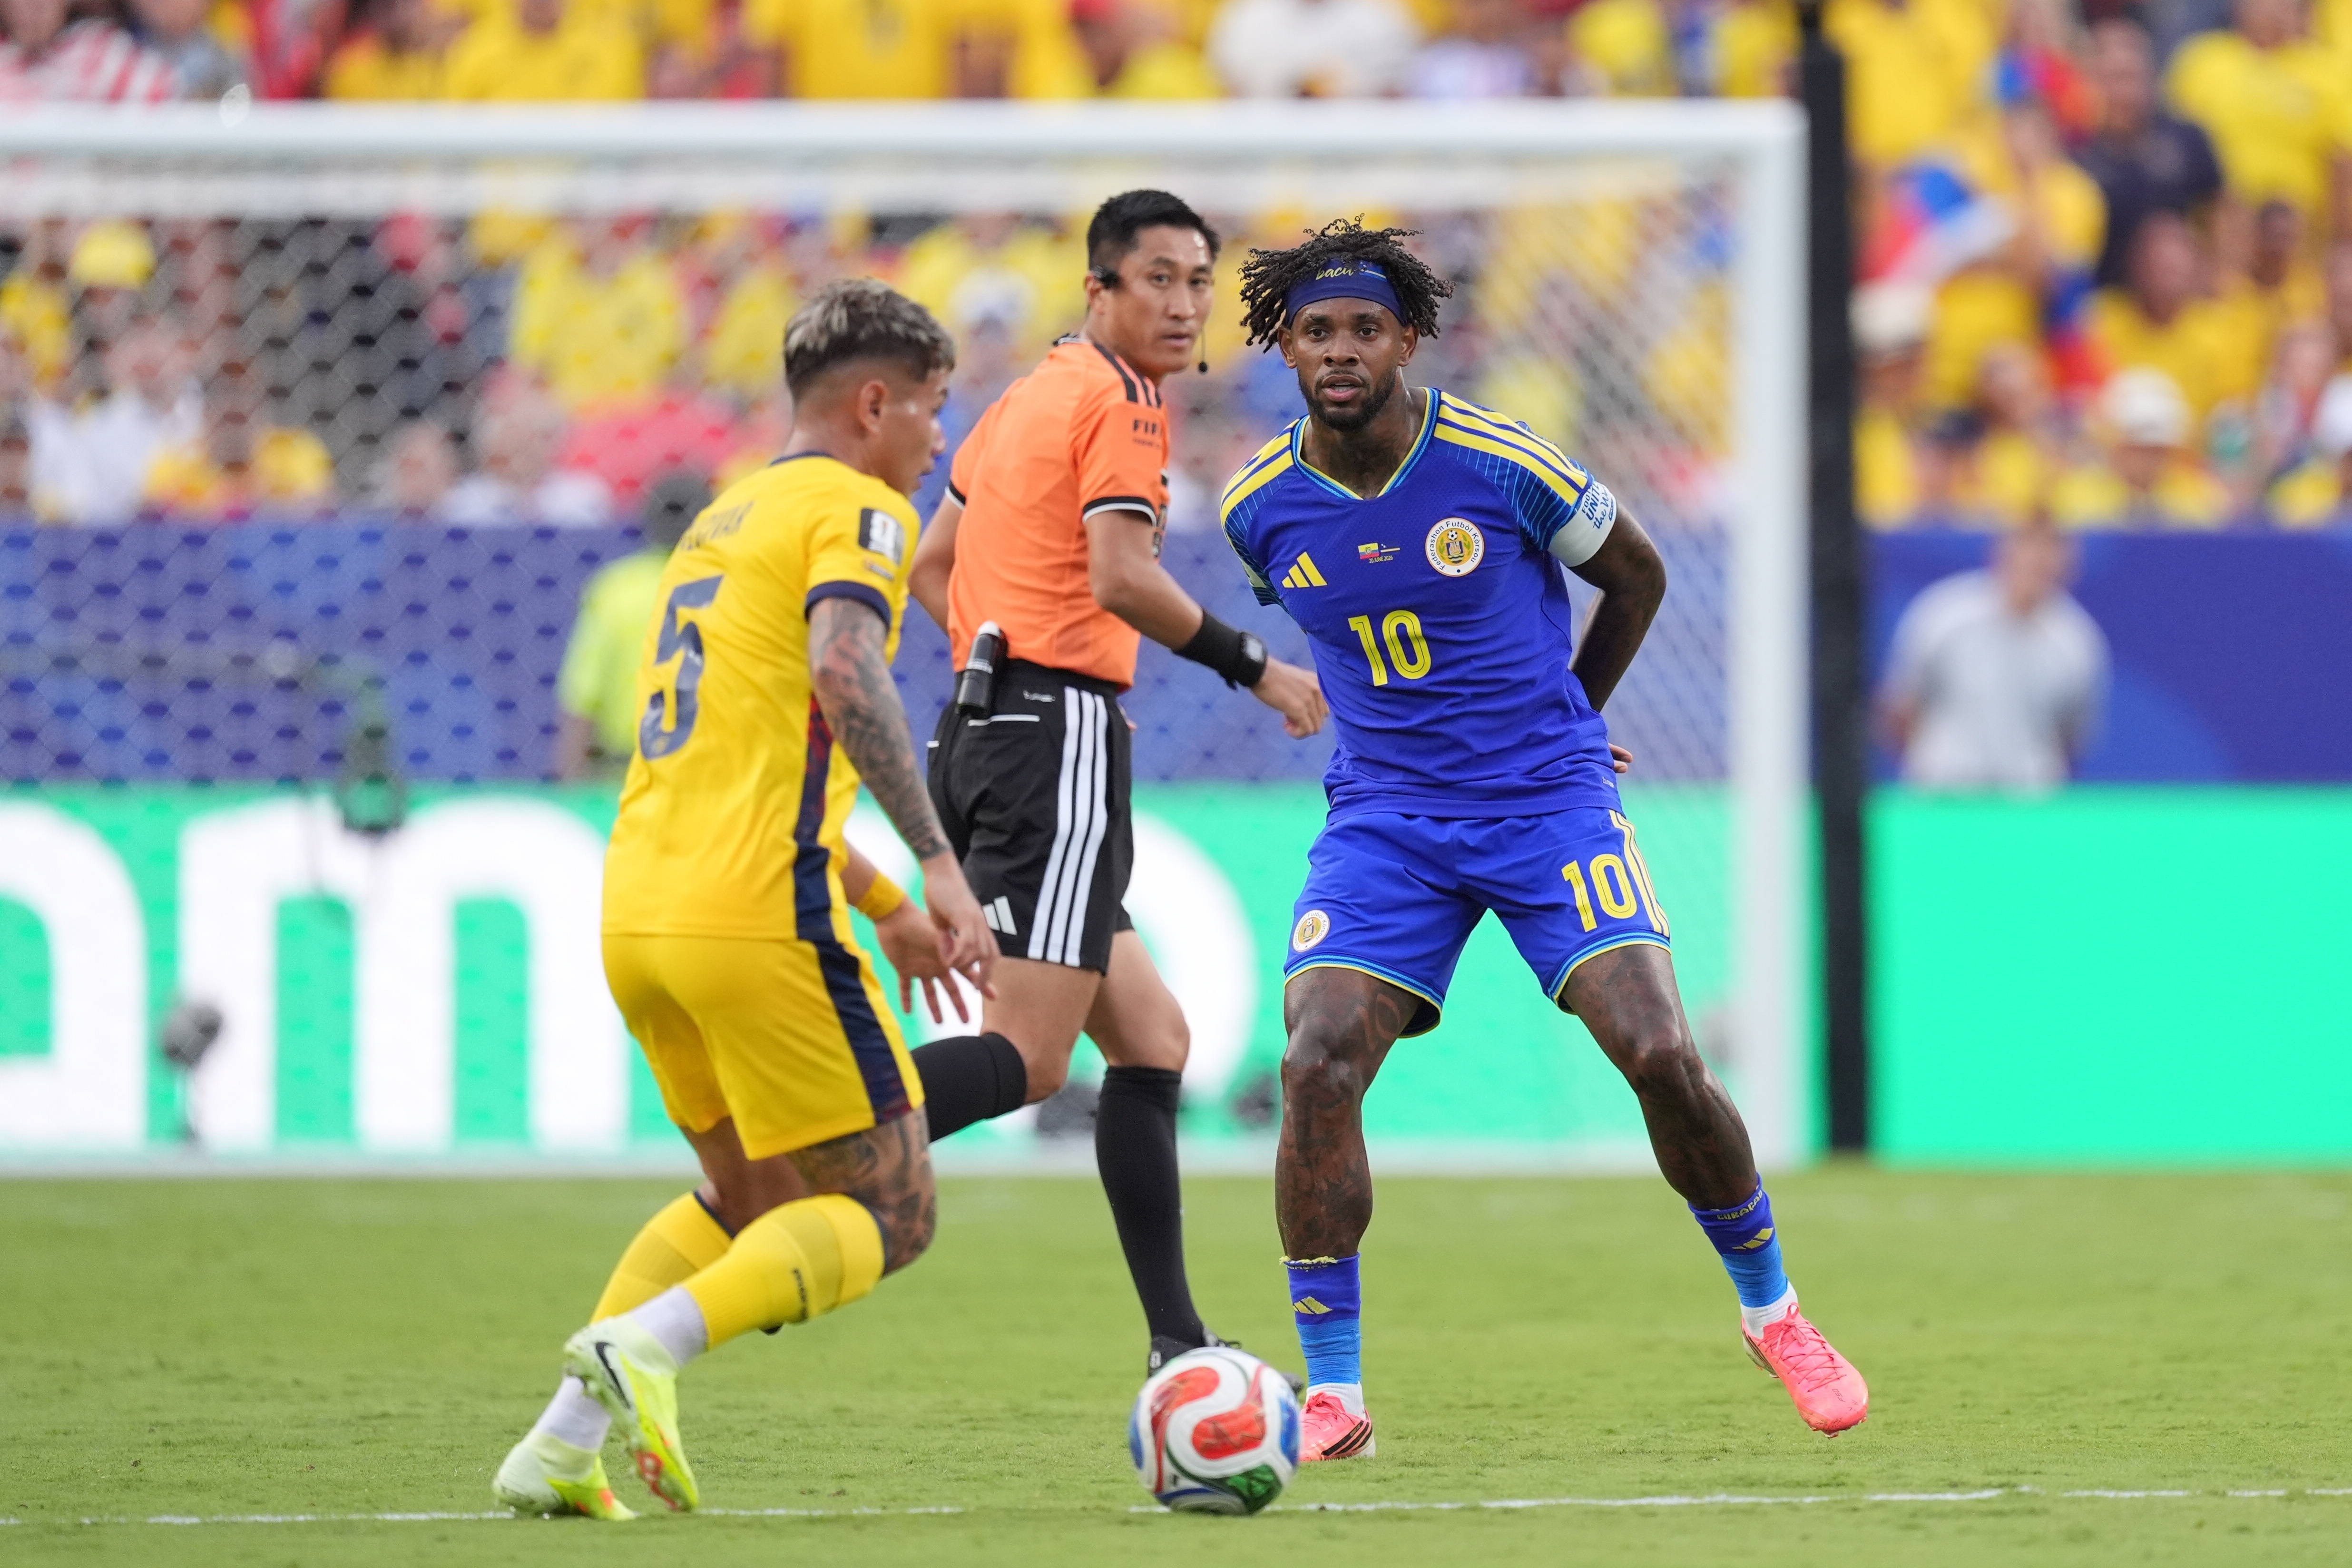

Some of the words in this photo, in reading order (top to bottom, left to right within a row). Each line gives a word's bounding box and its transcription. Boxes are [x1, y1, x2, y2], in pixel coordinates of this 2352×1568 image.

[1430, 526, 1445, 570] Federashon
[639, 574, 725, 761] 5
[1348, 610, 1432, 686] 10
[1561, 853, 1638, 932] 10
